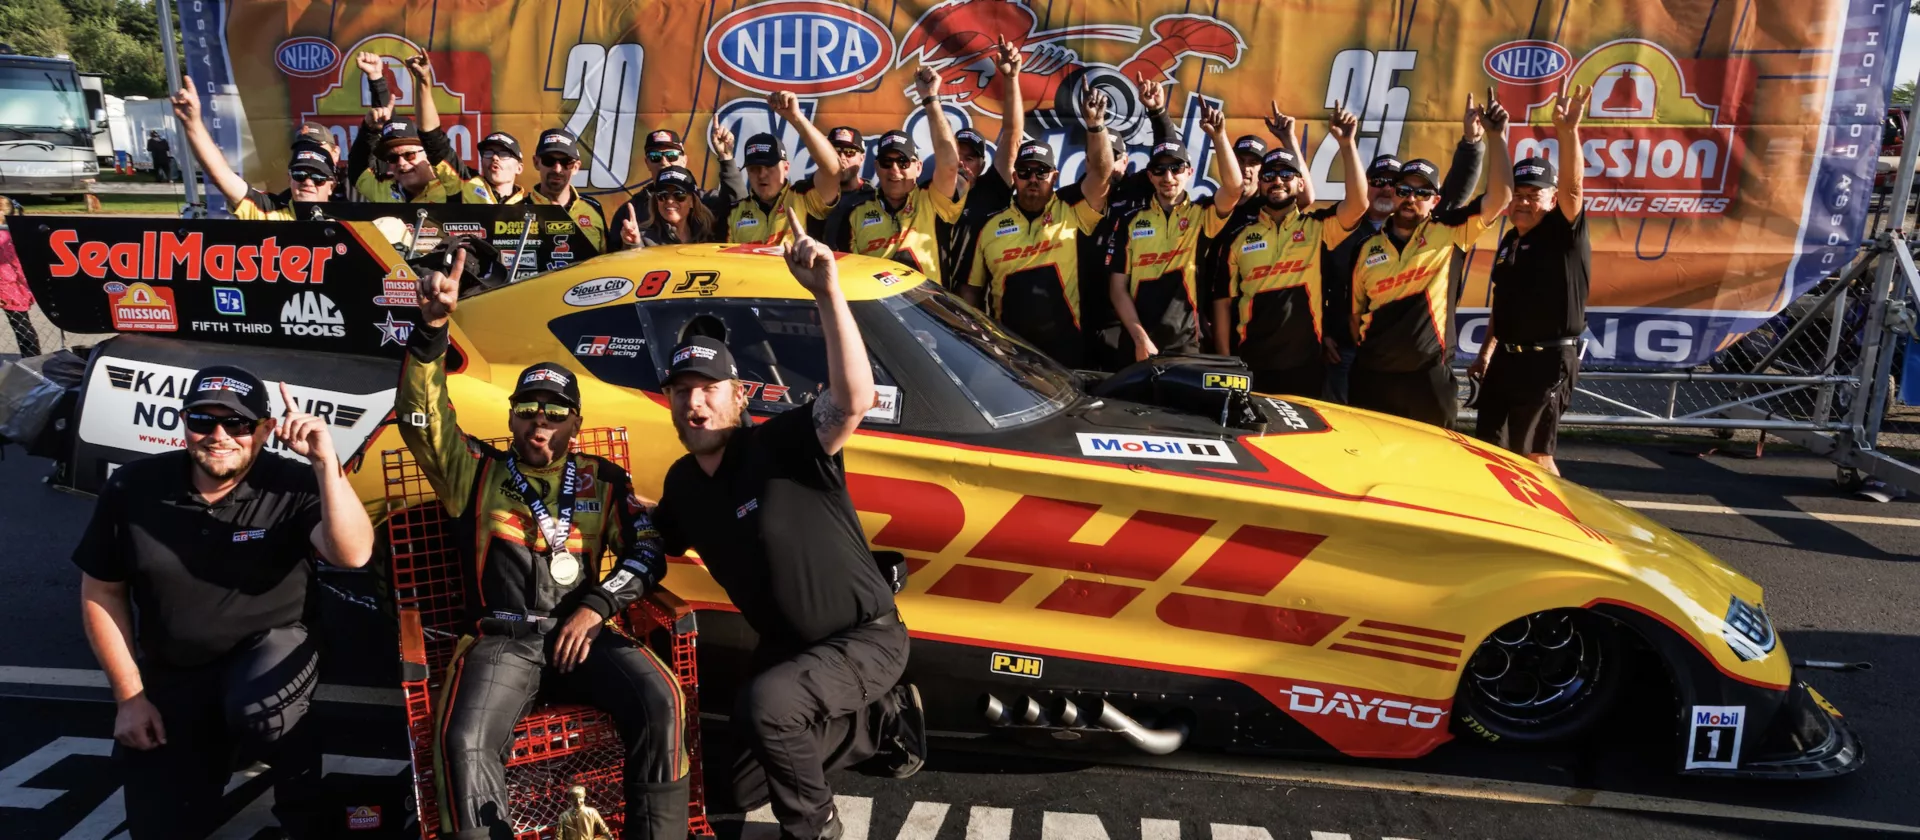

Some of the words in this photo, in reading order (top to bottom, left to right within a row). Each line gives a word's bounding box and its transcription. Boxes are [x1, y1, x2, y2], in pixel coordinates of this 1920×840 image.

[281, 46, 333, 71] NHRA
[736, 18, 867, 78] NHRA
[1860, 31, 1879, 87] HOT
[1497, 48, 1559, 78] NHRA
[562, 43, 644, 188] 20
[1847, 103, 1867, 158] ROD
[1514, 138, 1719, 179] MSSION
[1647, 197, 1731, 214] SERIES
[1252, 259, 1306, 281] DHL
[1366, 257, 1381, 265] Mobil
[385, 281, 416, 290] MISSIO
[571, 284, 602, 297] Sioux
[604, 279, 627, 291] City
[635, 270, 671, 298] 8
[280, 291, 344, 324] MAC
[192, 320, 229, 333] FIFTH
[233, 322, 273, 334] THIRD
[280, 323, 346, 338] TOOLS
[576, 343, 607, 355] GR
[608, 343, 641, 351] GAZOO
[611, 337, 646, 345] TOYOTA
[606, 350, 638, 359] Racing
[225, 377, 253, 390] TOYOTA
[1206, 374, 1248, 391] PJH
[1091, 437, 1184, 455] Mobil
[506, 457, 528, 494] NHRA
[563, 460, 576, 494] NHRA
[846, 472, 1347, 648] DHL
[994, 654, 1041, 677] PJH
[1281, 684, 1448, 730] DAYCO
[1696, 711, 1739, 726] Mobil
[1461, 714, 1501, 743] EAGLE
[1706, 729, 1721, 759] 1
